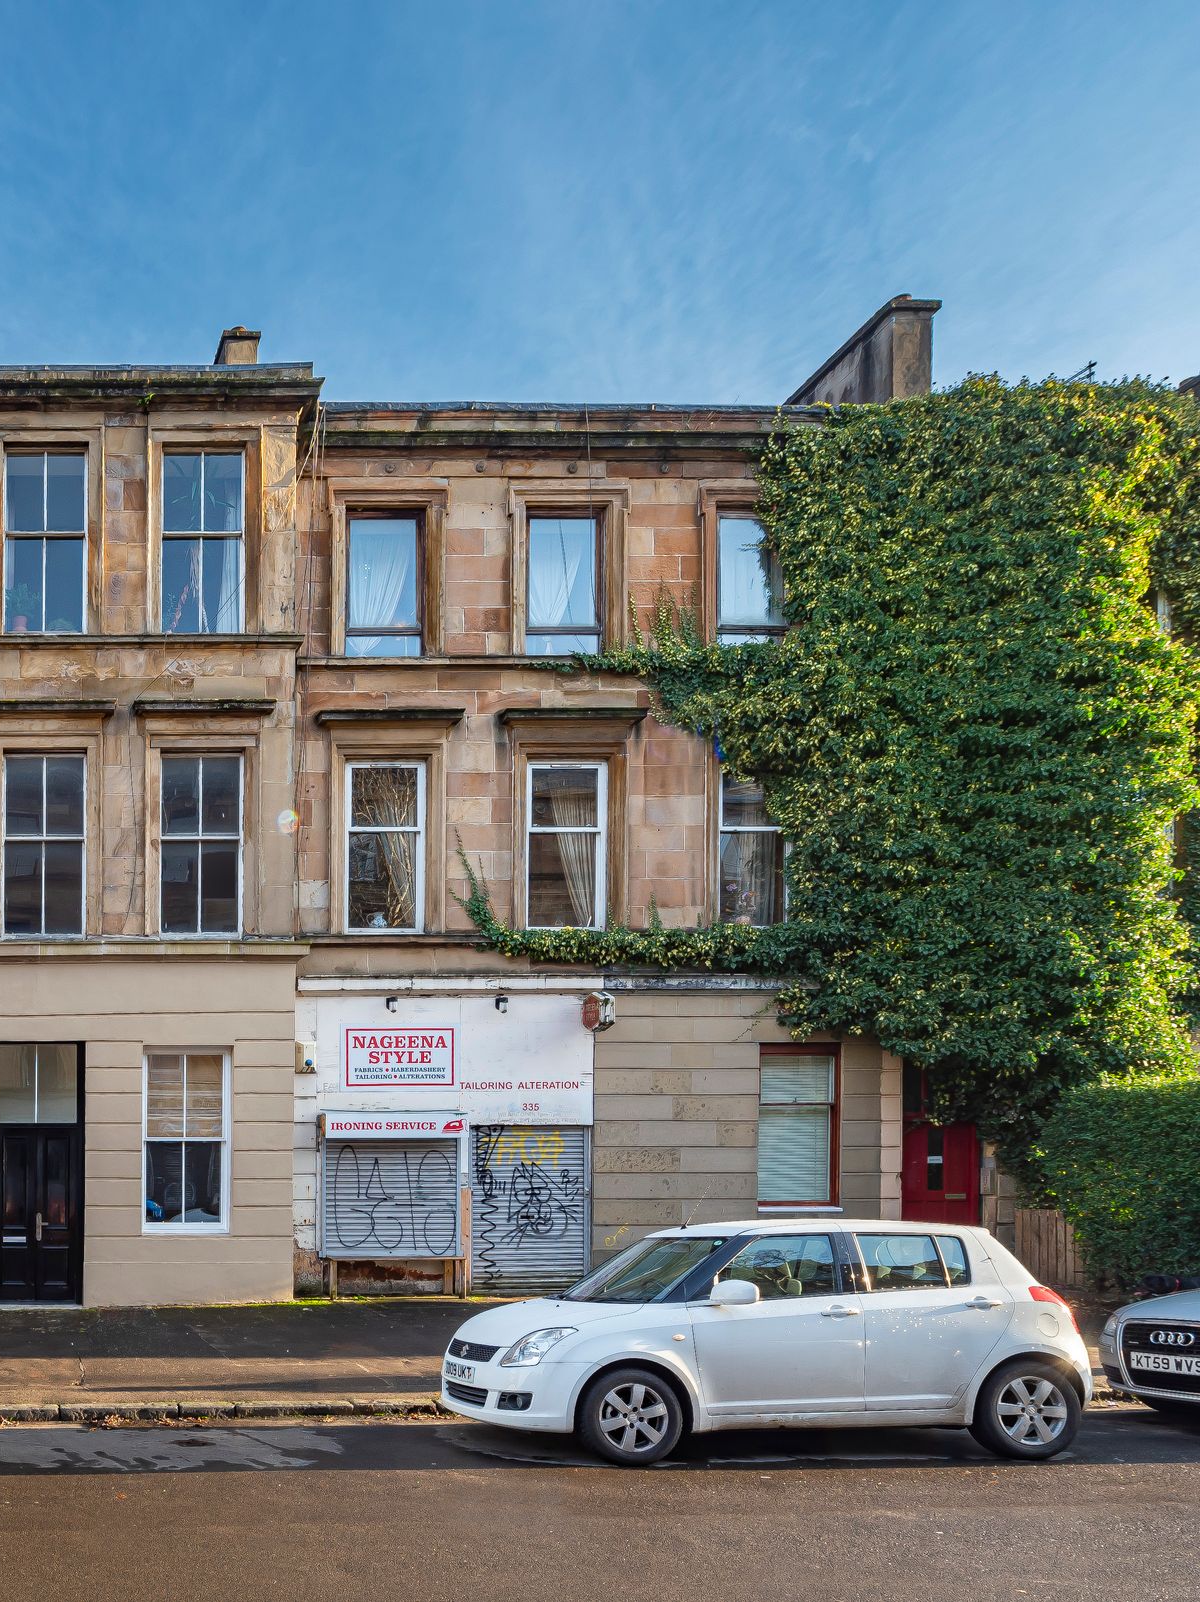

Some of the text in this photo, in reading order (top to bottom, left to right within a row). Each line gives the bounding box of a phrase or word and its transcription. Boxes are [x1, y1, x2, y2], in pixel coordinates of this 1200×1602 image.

[352, 1035, 448, 1049] NAGEENA
[368, 1050, 432, 1064] STYLE
[460, 1081, 513, 1090] TAILORING
[522, 1102, 540, 1112] 335
[330, 1121, 437, 1131] IRONING SERVICE
[1135, 1354, 1170, 1370] KT59
